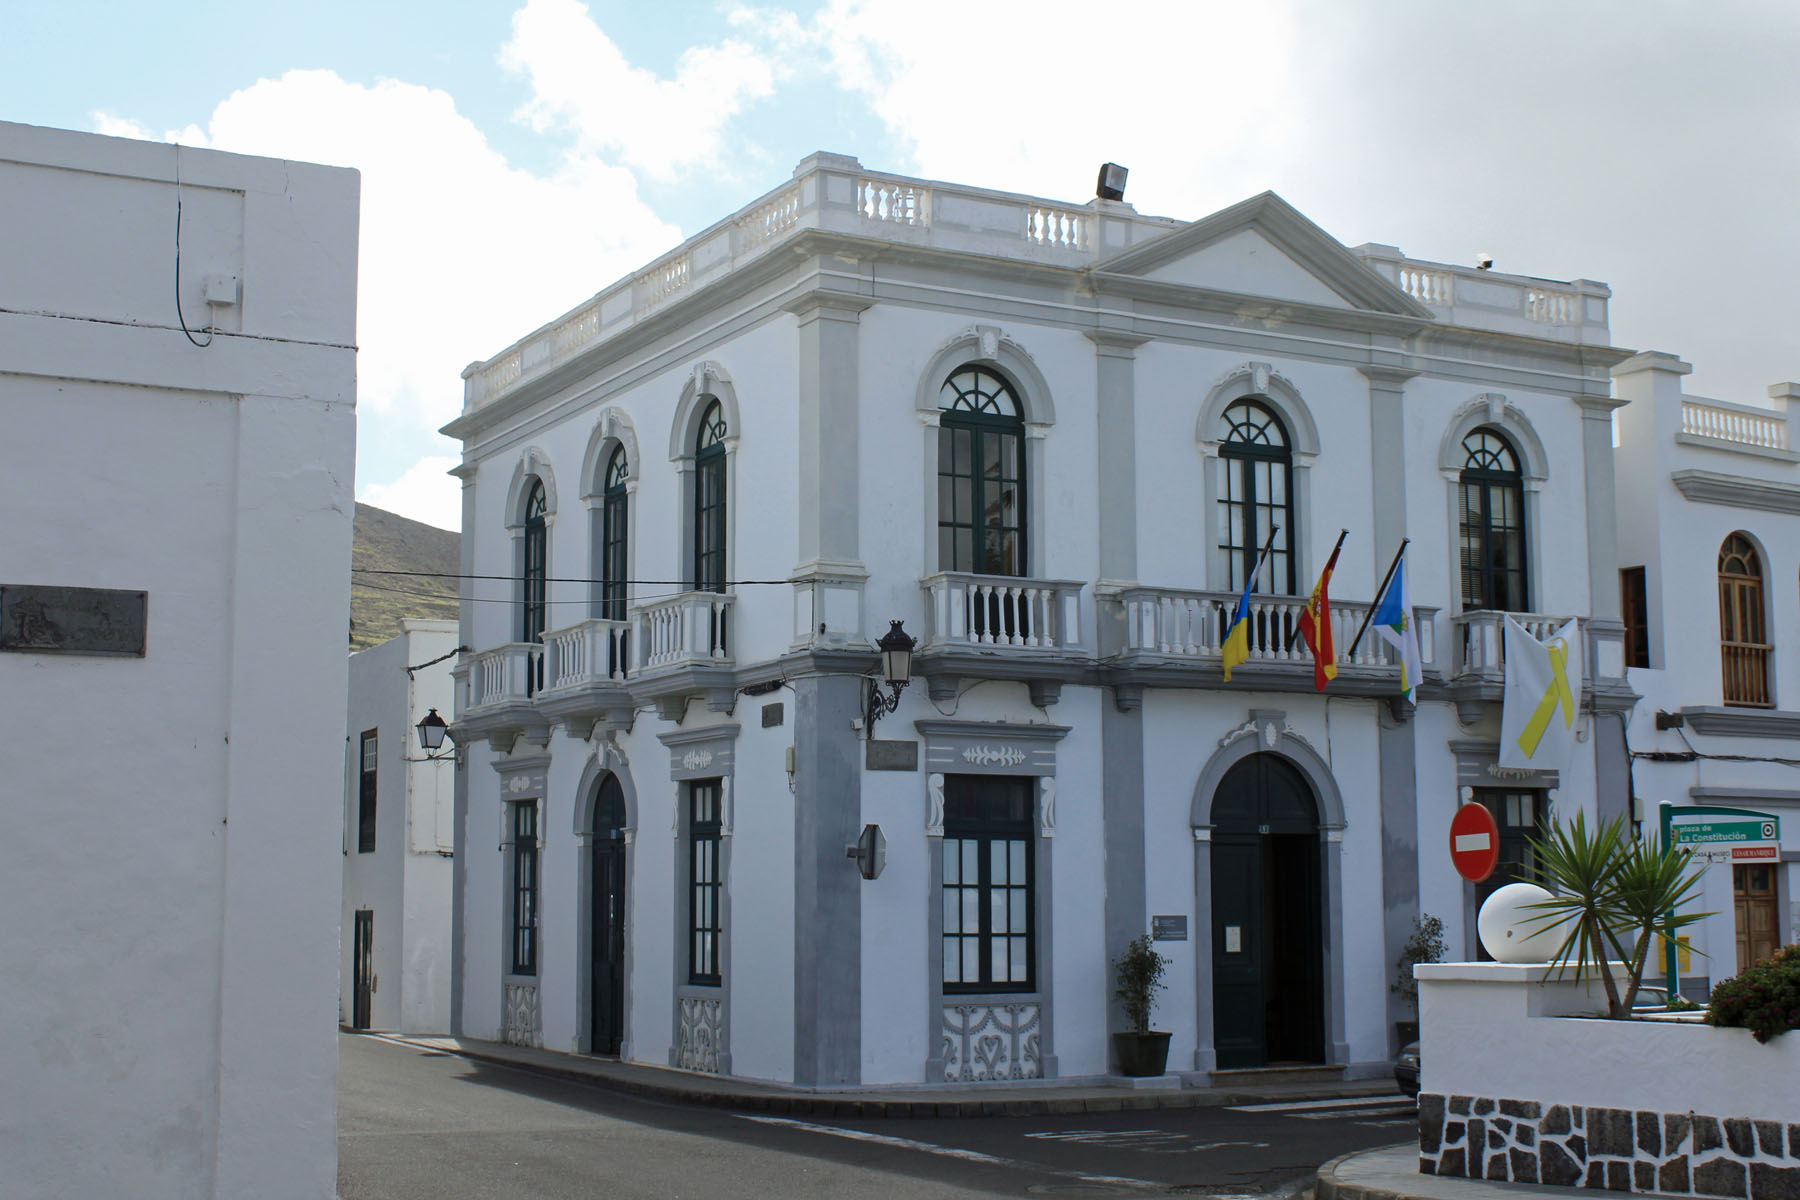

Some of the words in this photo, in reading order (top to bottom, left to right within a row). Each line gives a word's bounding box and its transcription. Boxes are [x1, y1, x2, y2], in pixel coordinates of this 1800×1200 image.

[1680, 825, 1700, 833] plaza
[1702, 824, 1712, 832] de
[1680, 834, 1690, 842] La
[1692, 831, 1747, 841] Constitución
